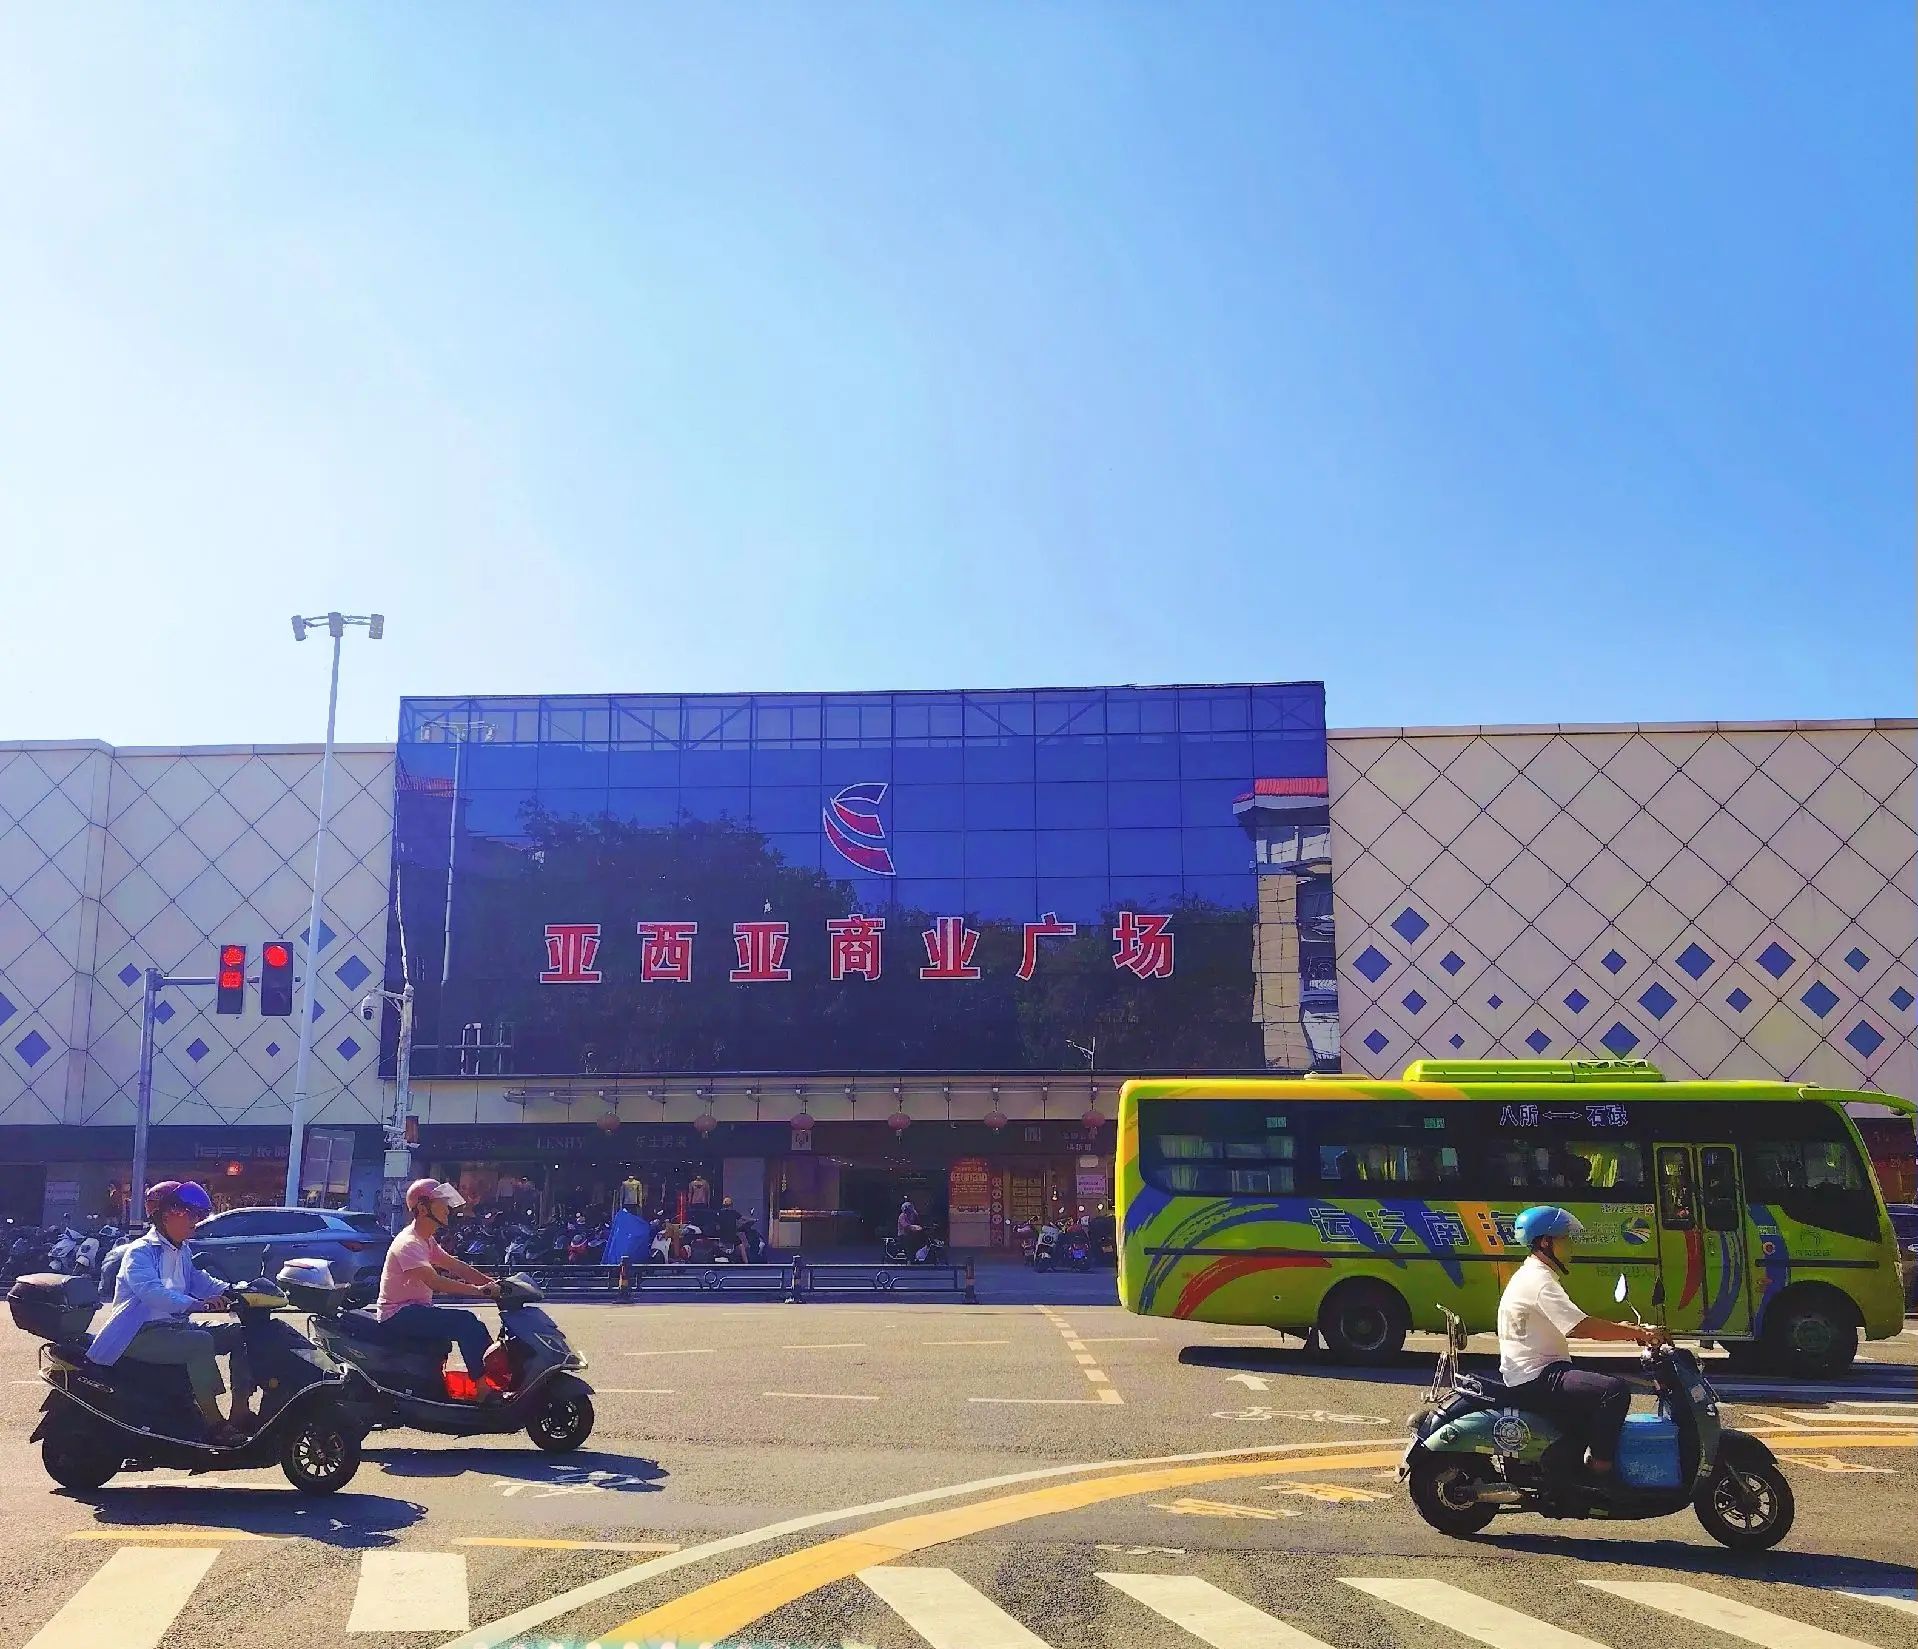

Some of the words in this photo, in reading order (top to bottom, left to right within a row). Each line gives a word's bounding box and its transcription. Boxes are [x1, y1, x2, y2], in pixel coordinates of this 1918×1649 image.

[539, 912, 1176, 983] 亚西亚商业广场
[1499, 1104, 1539, 1127] 八所
[1585, 1104, 1629, 1127] 石碌
